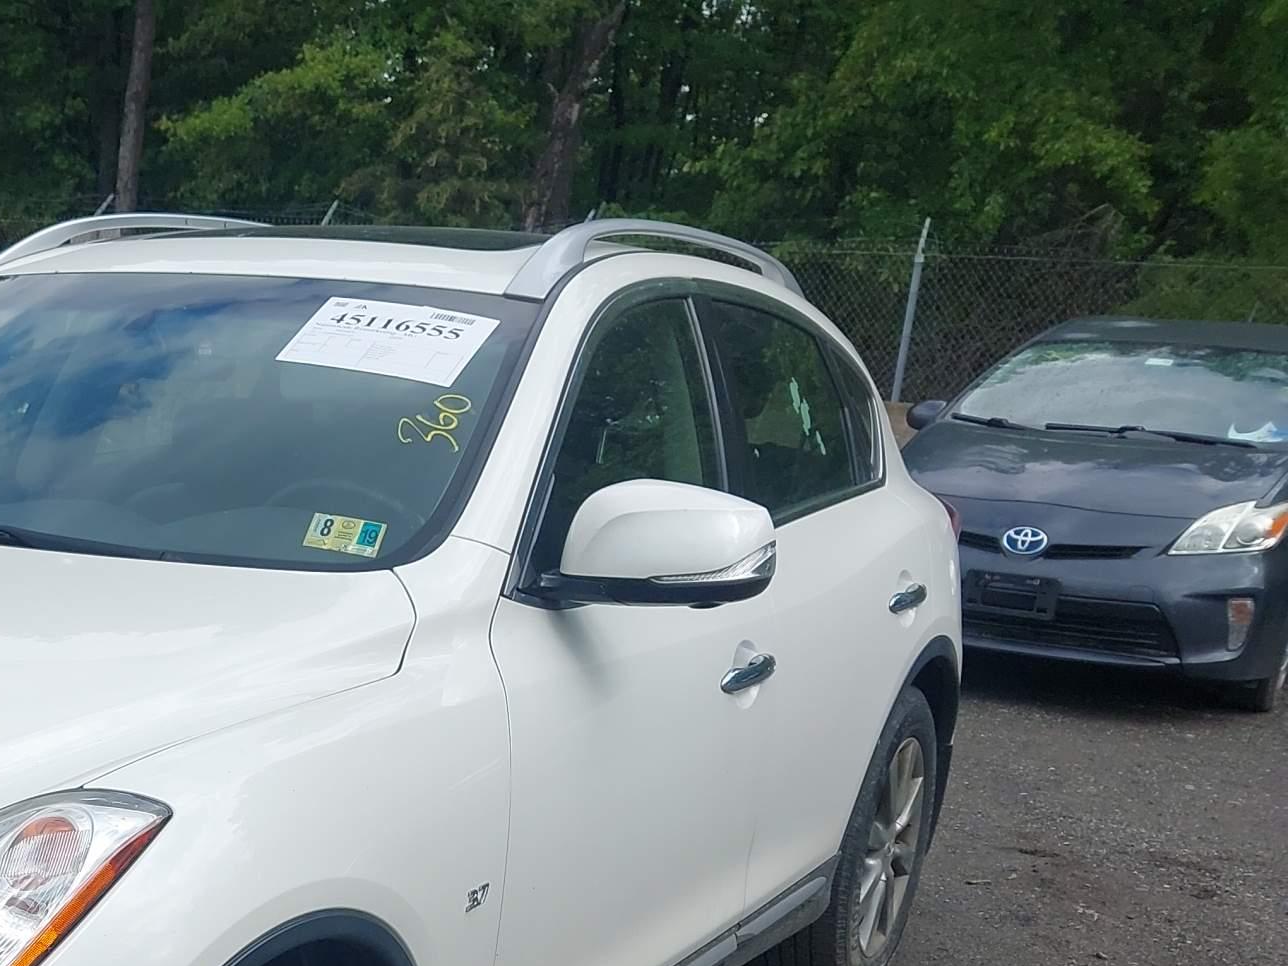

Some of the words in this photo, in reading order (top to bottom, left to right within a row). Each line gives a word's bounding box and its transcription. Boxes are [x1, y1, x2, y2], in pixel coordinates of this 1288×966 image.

[330, 312, 464, 340] 45116555
[398, 394, 472, 452] 360
[320, 518, 335, 537] 8
[362, 527, 379, 545] 19
